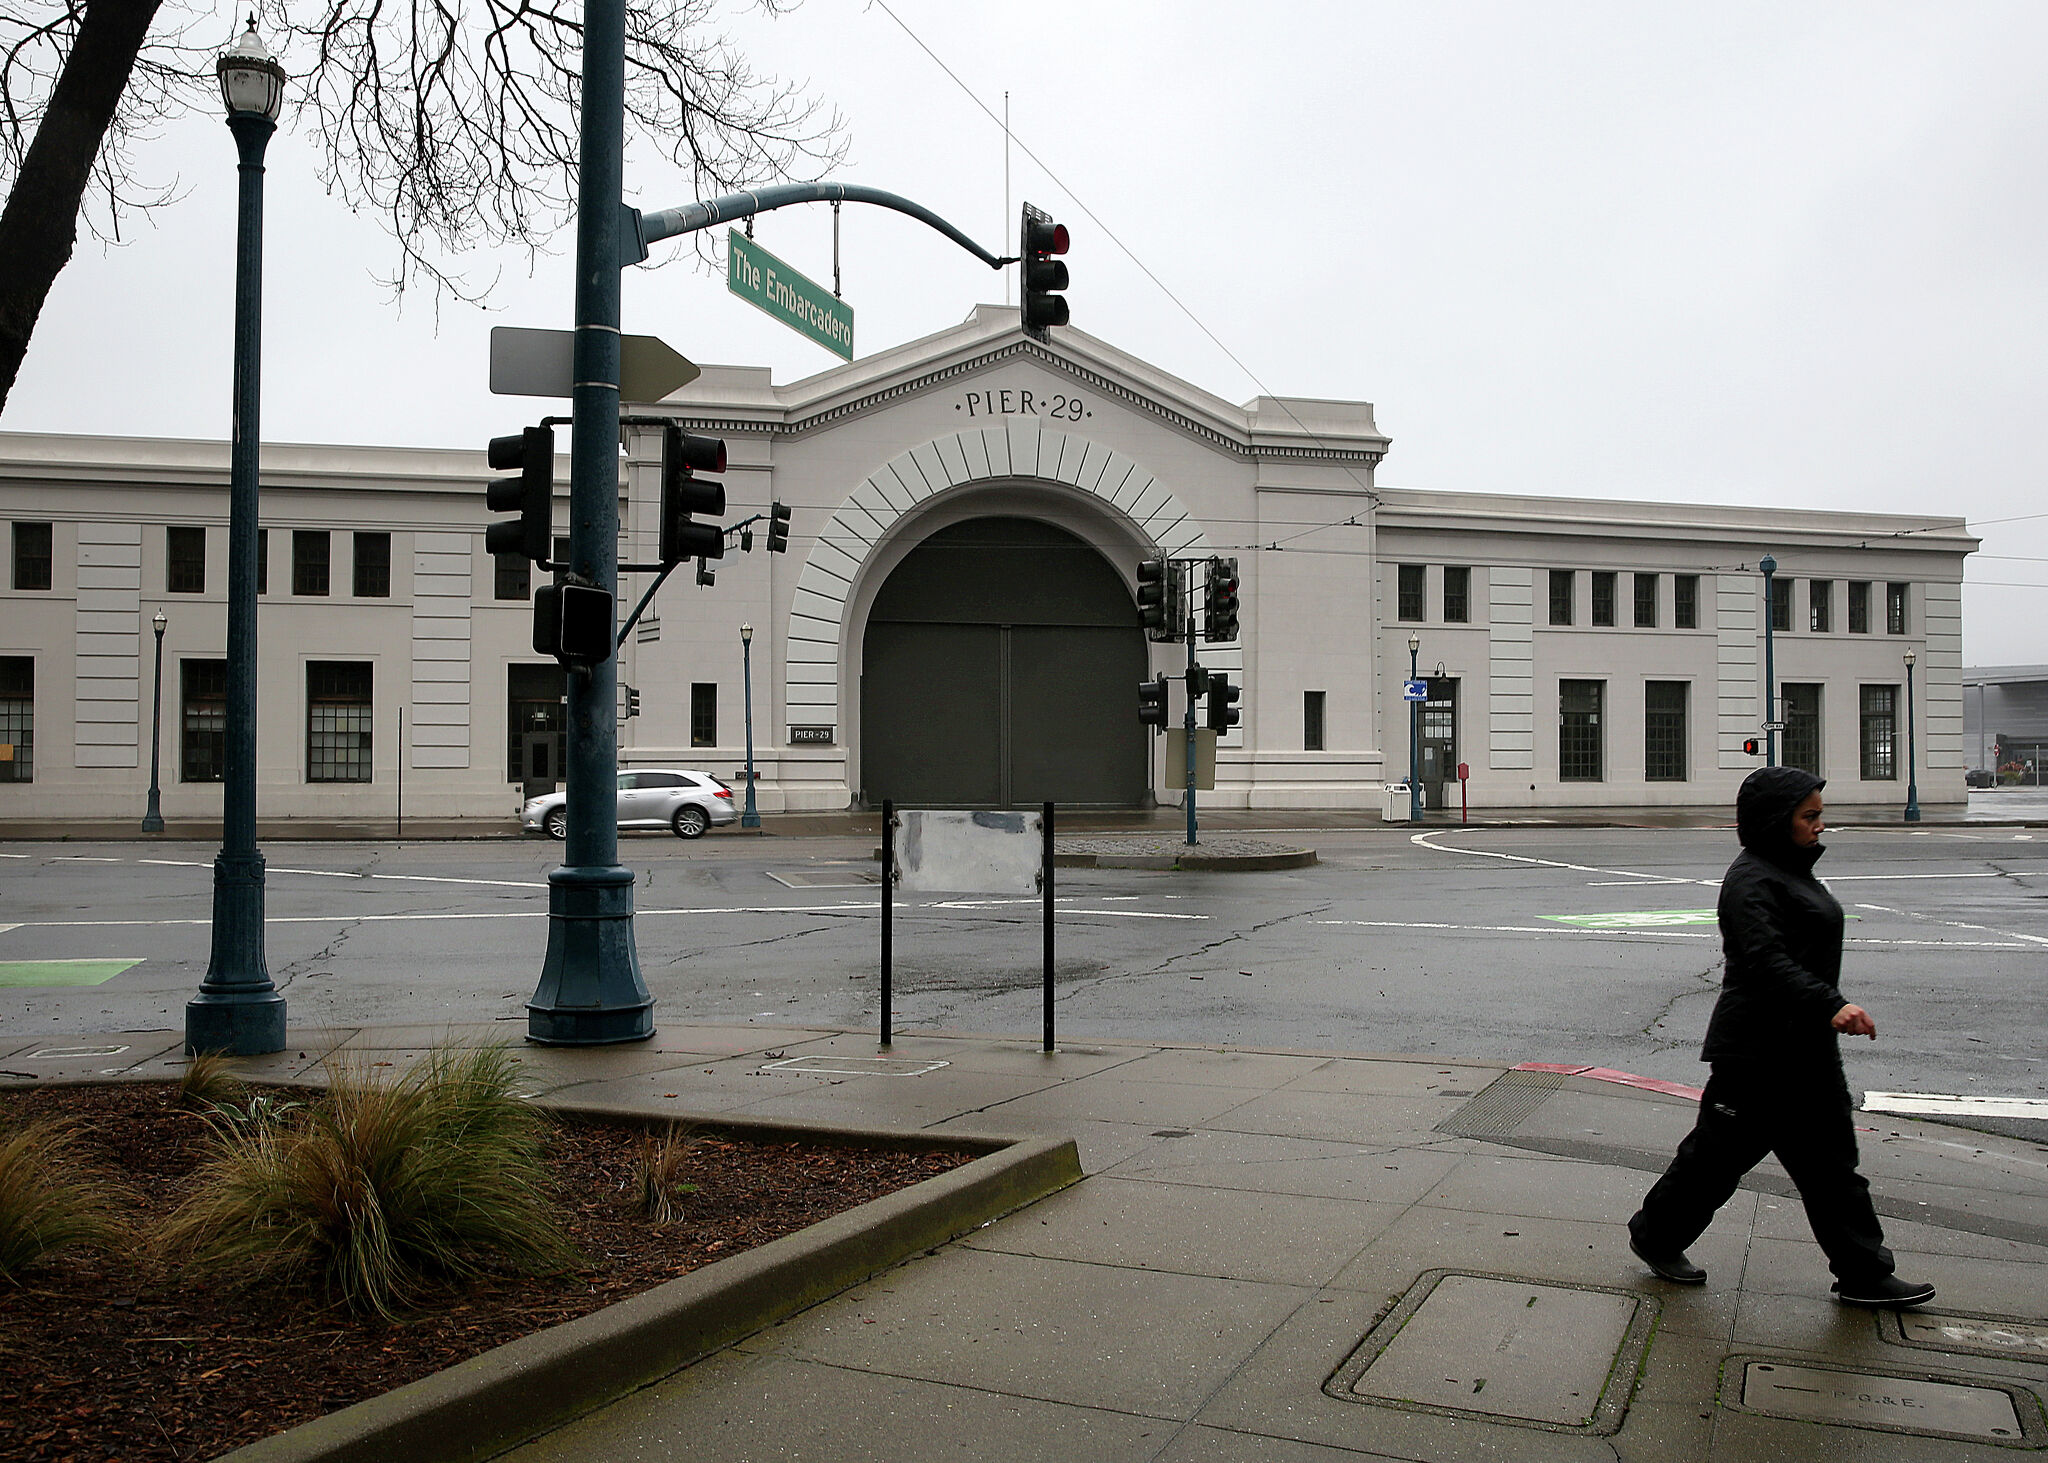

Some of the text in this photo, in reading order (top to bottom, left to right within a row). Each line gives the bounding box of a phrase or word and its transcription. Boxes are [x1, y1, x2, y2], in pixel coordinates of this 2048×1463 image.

[733, 246, 851, 347] The Embarcadero
[966, 389, 1083, 422] PIER 29
